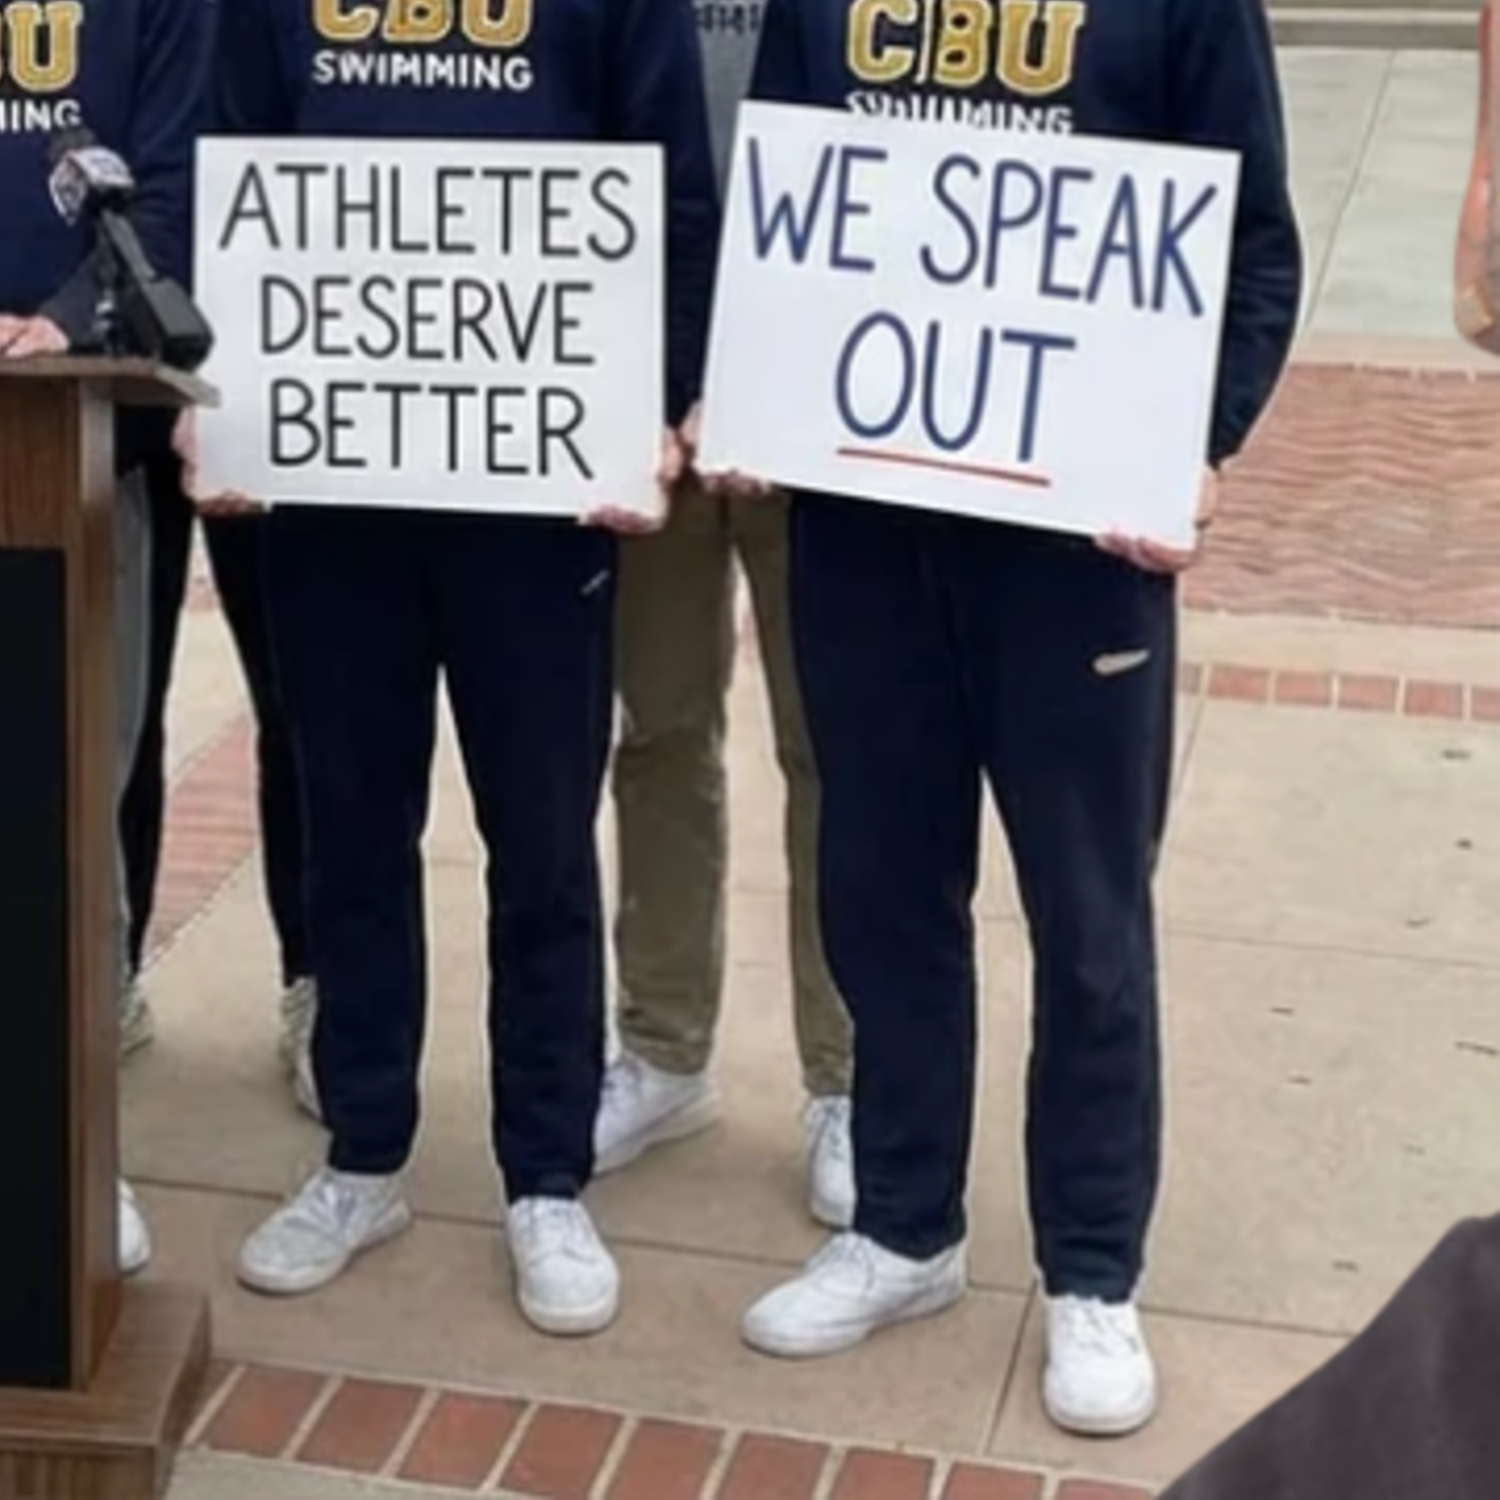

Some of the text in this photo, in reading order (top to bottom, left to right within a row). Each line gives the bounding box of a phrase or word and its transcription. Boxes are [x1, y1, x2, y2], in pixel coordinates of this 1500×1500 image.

[312, 49, 535, 92] SWIMMING
[218, 162, 637, 262] ATHLETES
[747, 136, 1219, 318] WE SPEAK
[260, 274, 595, 366] DESERVE
[269, 378, 595, 480] BETTER
[835, 311, 1077, 463] OUT
